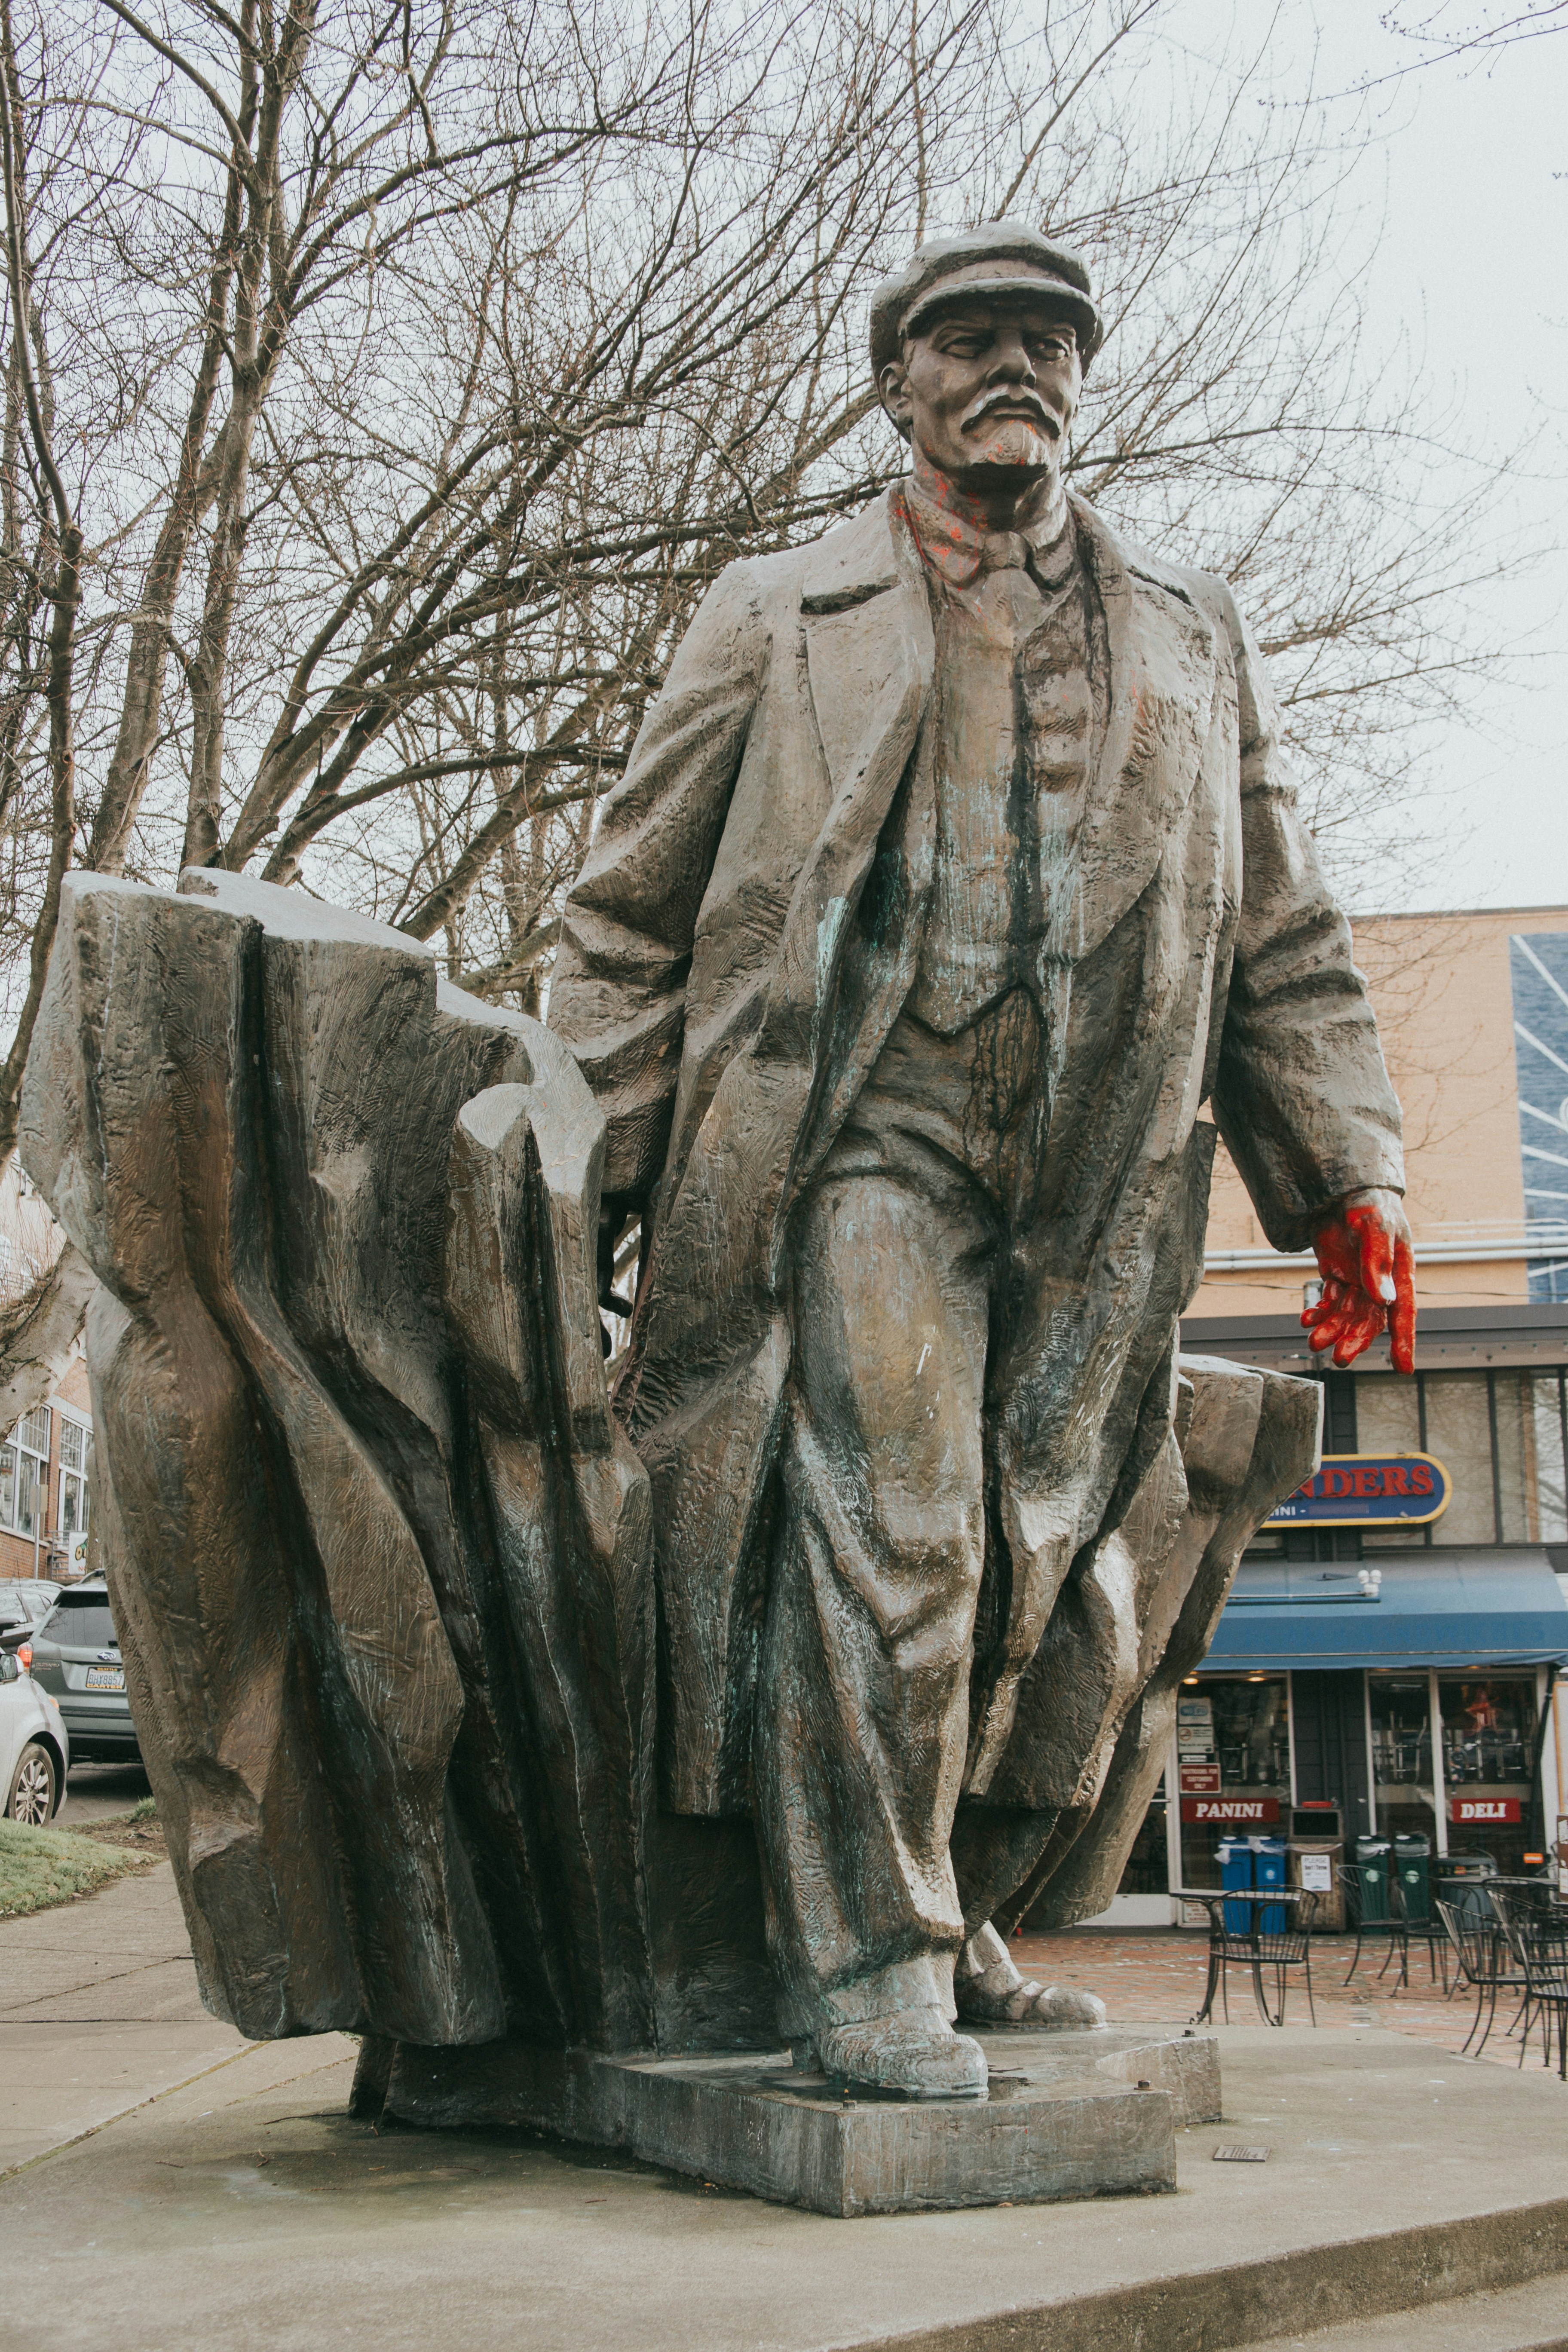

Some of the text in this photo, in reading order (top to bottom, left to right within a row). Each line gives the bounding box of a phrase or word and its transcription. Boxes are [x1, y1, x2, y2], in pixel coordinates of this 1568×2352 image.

[1270, 1506, 1295, 1516] INI
[89, 1674, 122, 1685] BHY8857
[1196, 1803, 1264, 1818] PANINI
[1460, 1803, 1507, 1818] DELI
